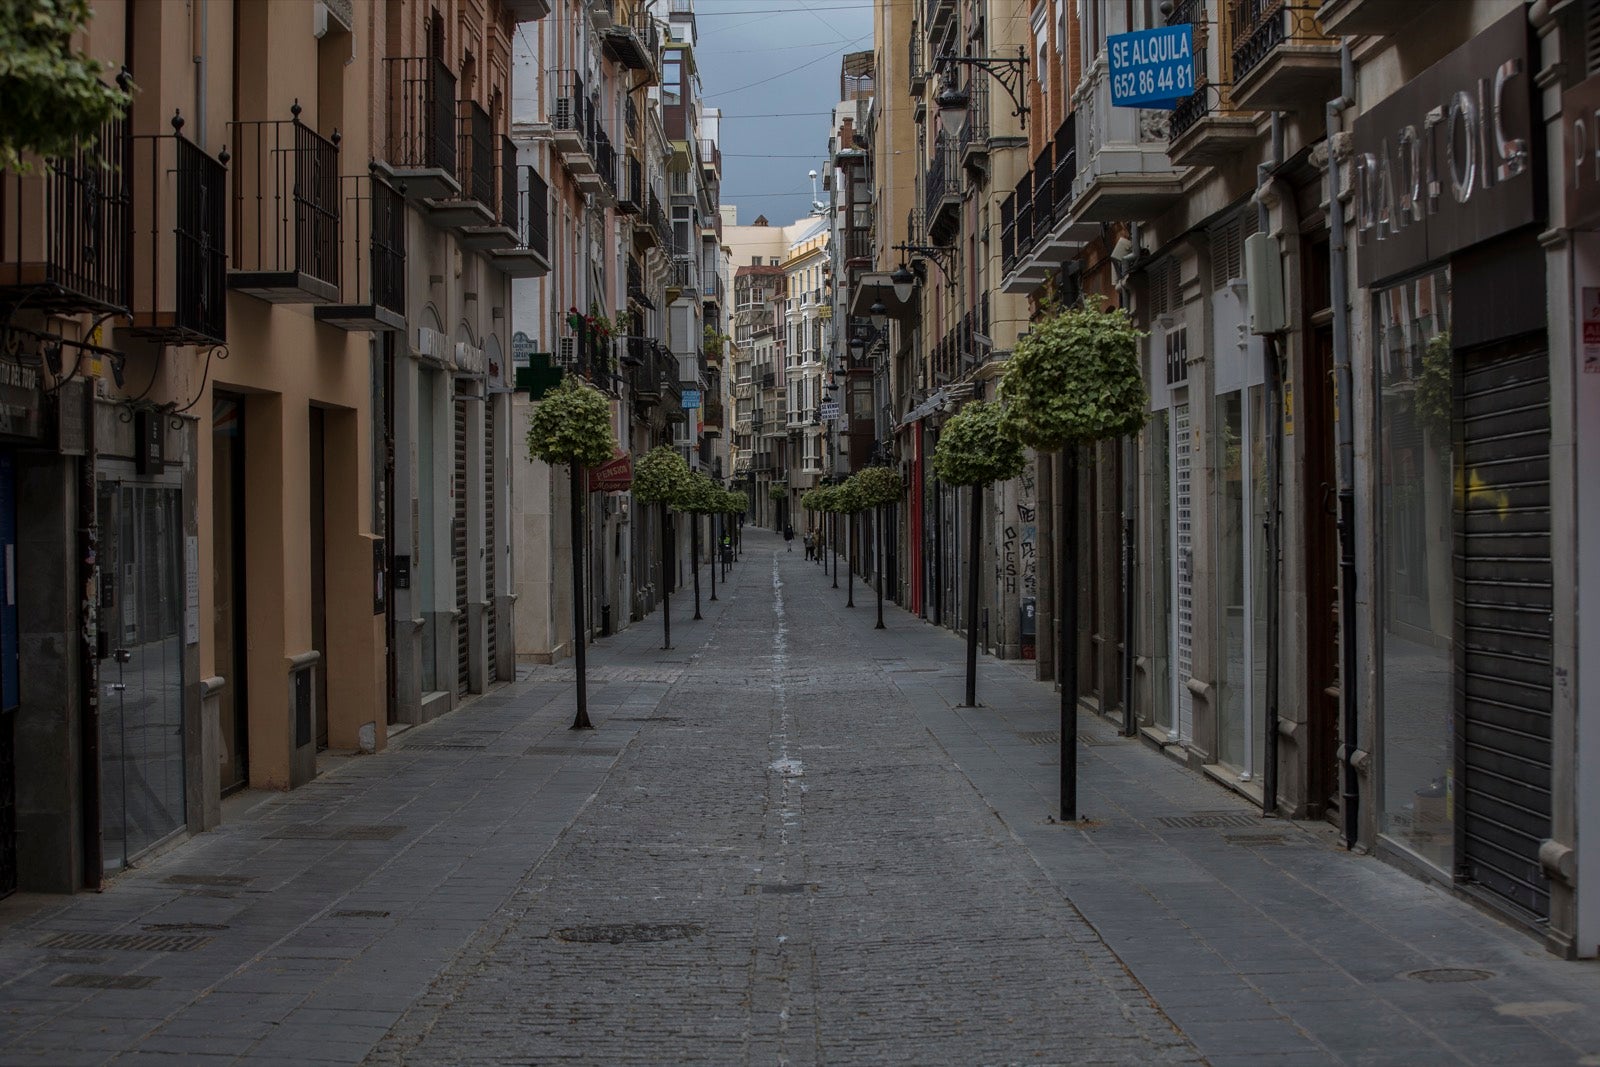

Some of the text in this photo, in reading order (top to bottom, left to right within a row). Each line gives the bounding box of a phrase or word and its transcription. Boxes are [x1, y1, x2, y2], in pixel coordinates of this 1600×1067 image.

[1112, 32, 1190, 69] SE ALQUILA
[1113, 63, 1192, 99] 652 86 44 81
